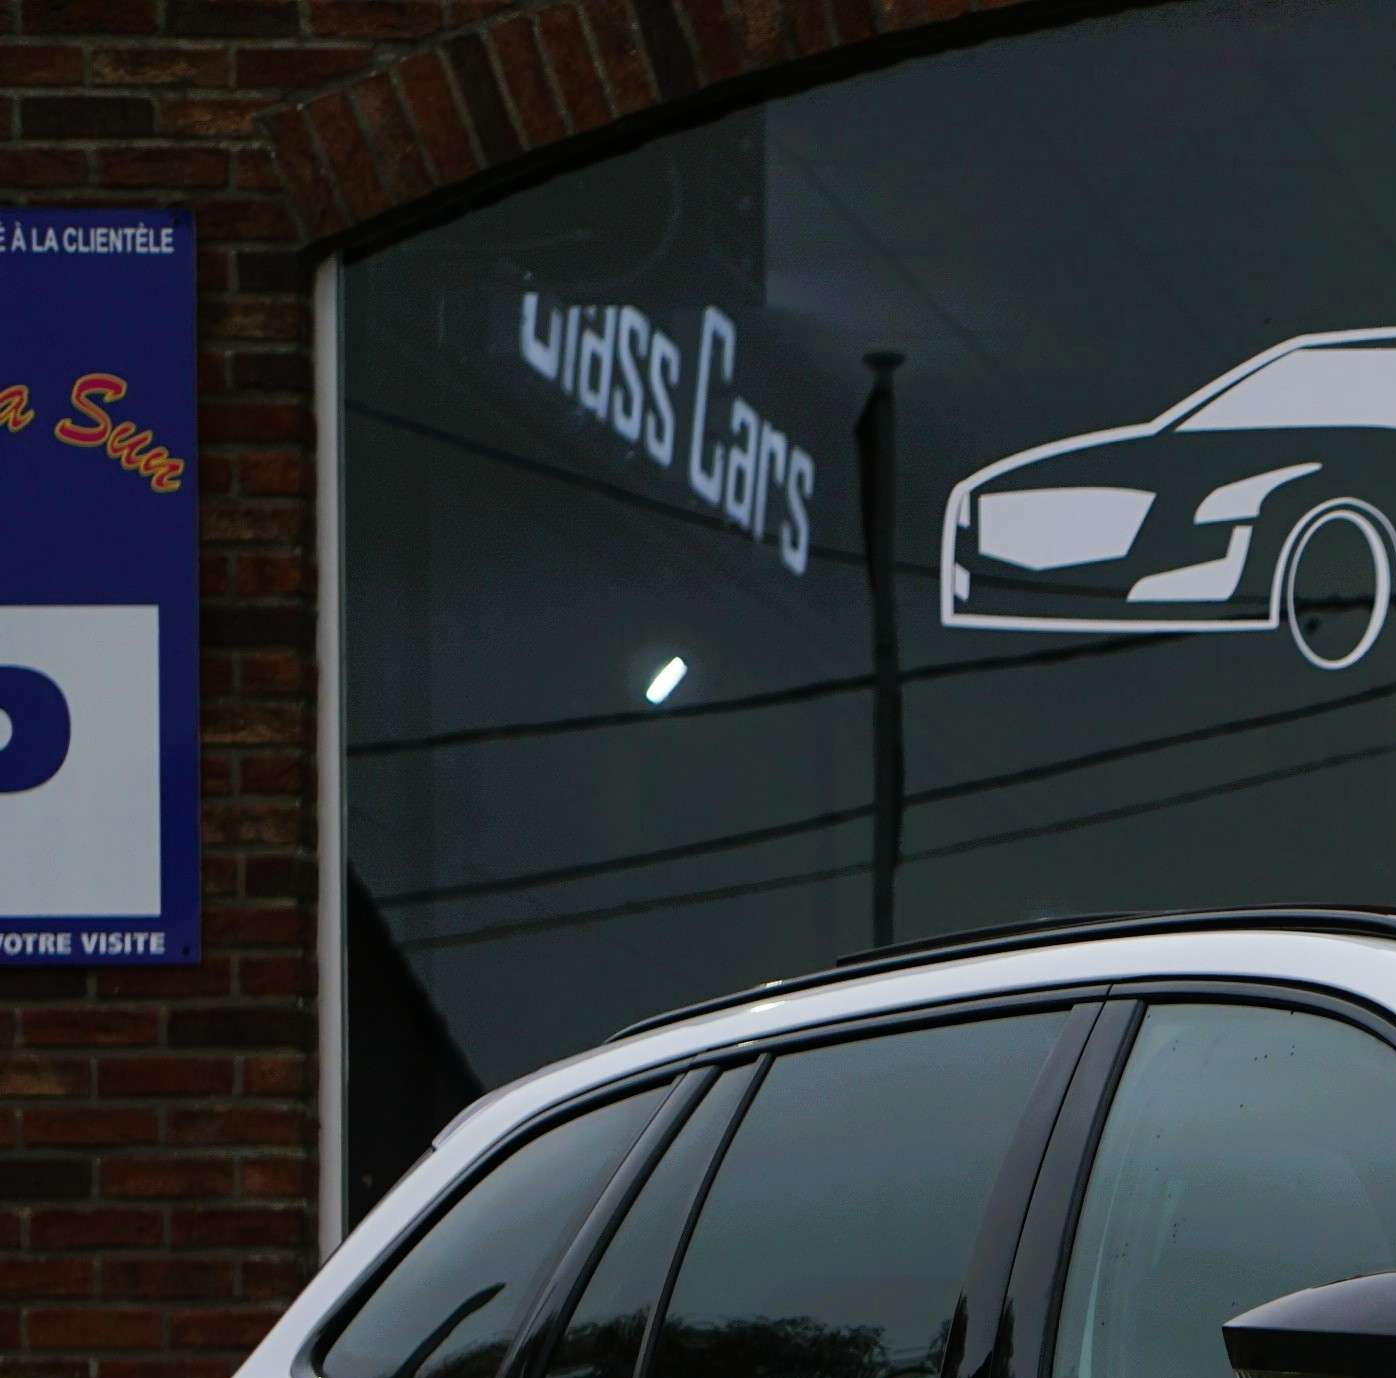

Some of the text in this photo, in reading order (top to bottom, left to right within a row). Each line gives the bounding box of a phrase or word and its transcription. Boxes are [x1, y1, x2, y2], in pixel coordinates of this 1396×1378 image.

[11, 221, 27, 252] À
[32, 227, 59, 252] LA
[63, 222, 175, 254] CLIENTÈLE
[55, 373, 185, 493] Sun
[689, 305, 815, 576] Cars
[0, 932, 166, 956] OTRE VISITE
